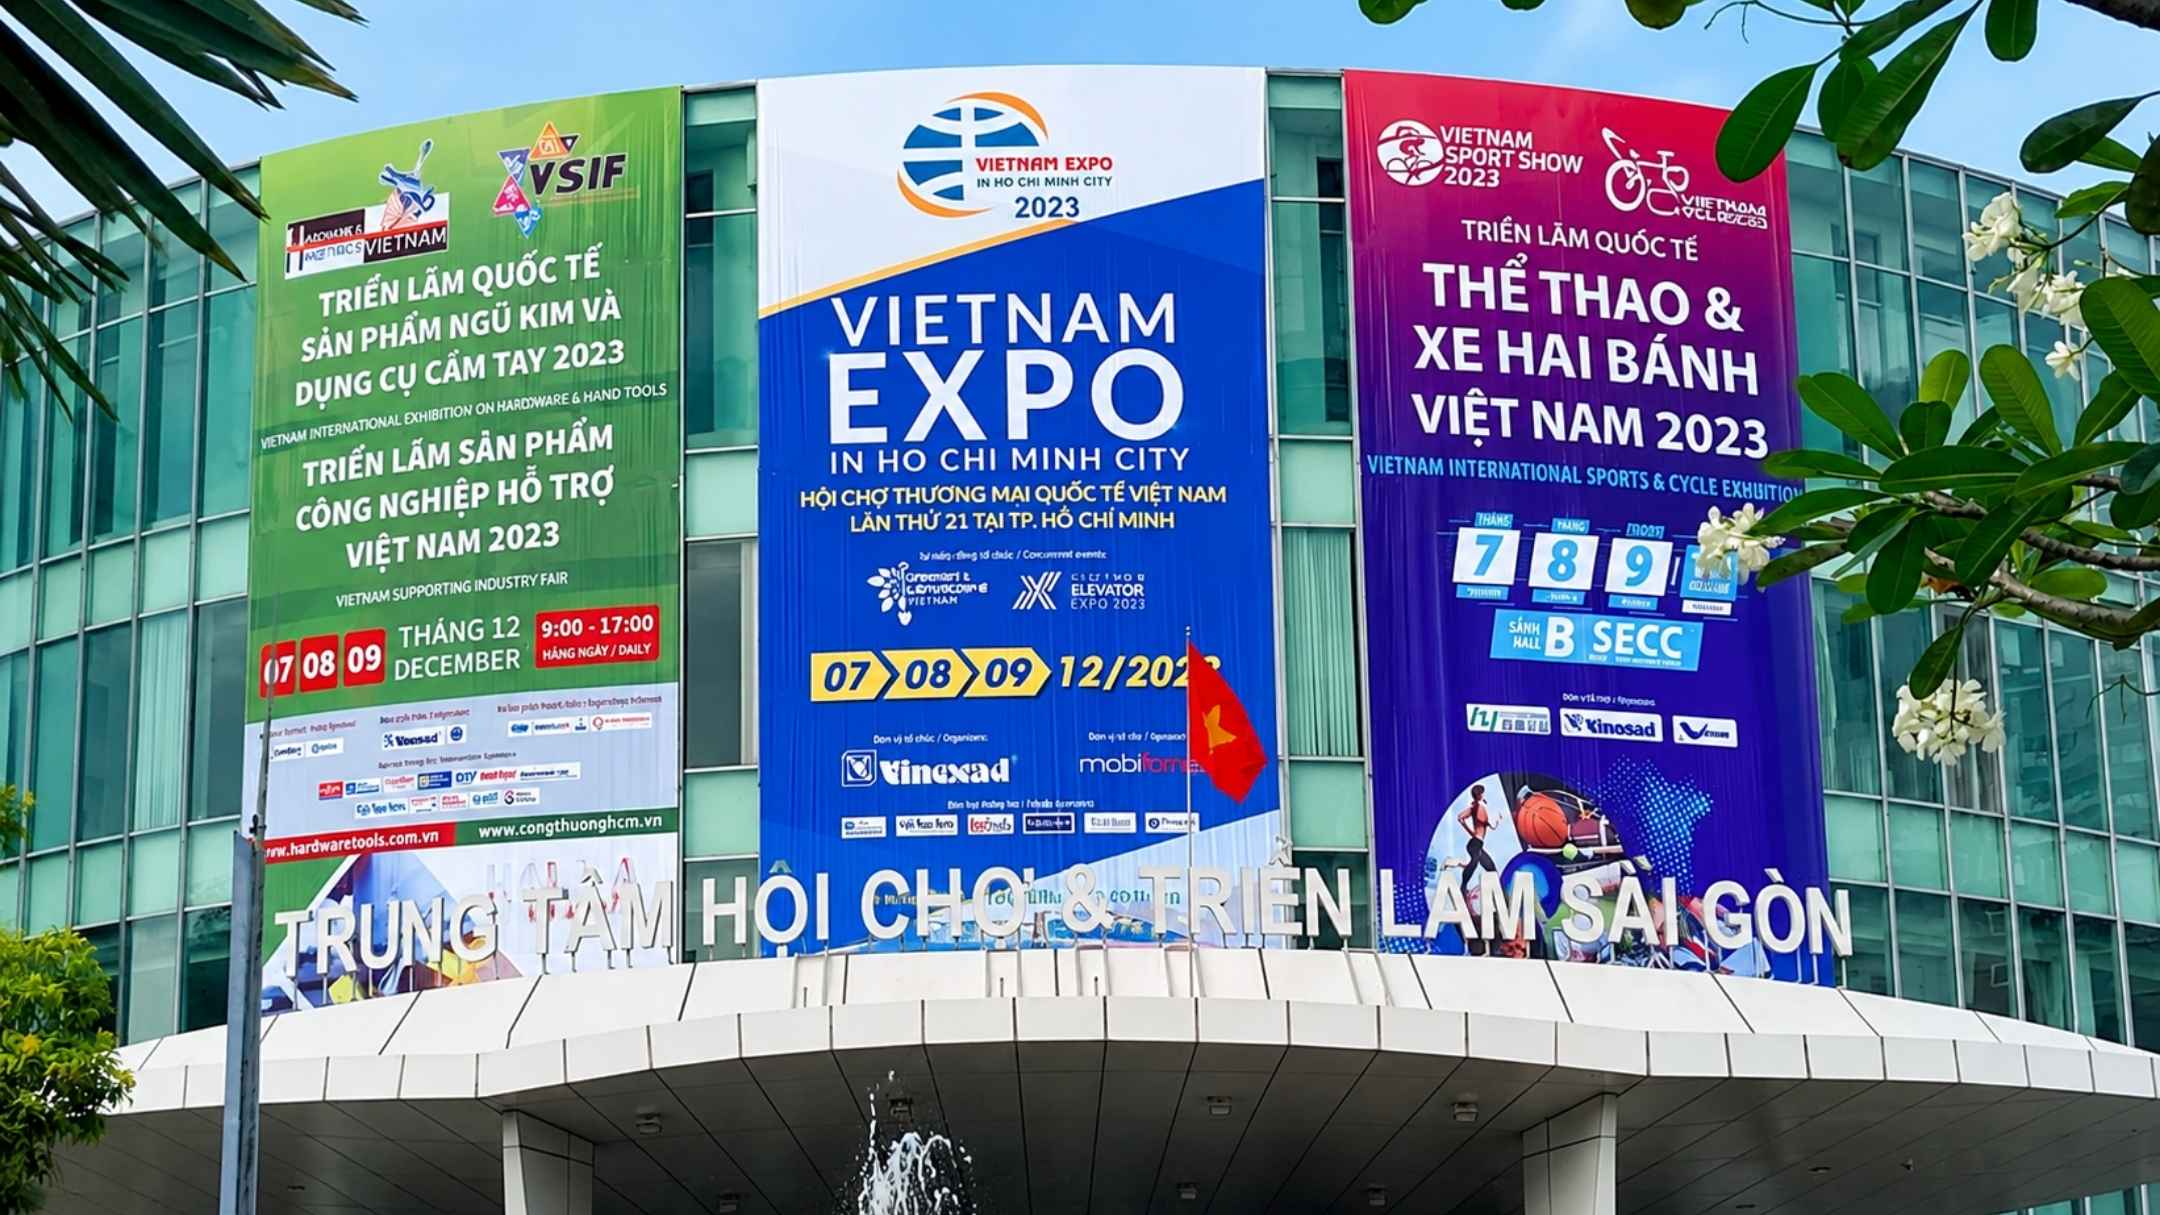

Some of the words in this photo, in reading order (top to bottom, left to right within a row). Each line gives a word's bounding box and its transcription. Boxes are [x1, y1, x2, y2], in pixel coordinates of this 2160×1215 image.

[1440, 126, 1533, 150] VIETNAM
[530, 154, 626, 196] VSIF
[975, 157, 1058, 172] VIETNAM
[1065, 156, 1113, 171] EXPO
[1444, 167, 1501, 188] 2023
[1445, 147, 1515, 169] SPORT
[1518, 152, 1584, 174] SHOW
[977, 178, 990, 188] IN
[994, 177, 1014, 188] HO
[1017, 177, 1040, 187] CHI
[1044, 176, 1079, 187] MINH
[1083, 176, 1113, 187] CITY
[1015, 196, 1080, 219] 2023
[365, 227, 447, 256] VIETNAM
[1538, 221, 1589, 249] LÃM
[1671, 233, 1699, 262] TẾ
[472, 250, 557, 297] QUỐC
[565, 242, 603, 280] TẾ
[520, 300, 575, 330] KIM
[582, 288, 621, 322] VÀ
[1422, 252, 1530, 313] THỂ
[1538, 270, 1690, 327] THAO
[1704, 286, 1744, 332] &
[830, 292, 1175, 347] VIETNAM
[295, 370, 372, 410] DỤNG
[379, 363, 417, 397] CỤ
[493, 347, 547, 377] TAY
[553, 339, 625, 370] 2023
[1413, 325, 1483, 372] XE
[1499, 329, 1592, 380] HAI
[1606, 334, 1759, 396] BÁNH
[829, 348, 1185, 445] EXPO
[261, 428, 307, 449] VIETNAM
[309, 413, 401, 440] INTERNATIONAL
[404, 405, 473, 424] EXHIBITION
[475, 402, 495, 415] ON
[583, 388, 622, 403] HAND
[624, 383, 667, 398] TOOLS
[1411, 388, 1519, 448] VIỆT
[1532, 400, 1644, 448] NAM
[1655, 411, 1769, 459] 2023
[830, 450, 864, 475] IN
[878, 449, 927, 473] HO
[940, 448, 996, 472] CHI
[1011, 447, 1101, 472] MINH
[1115, 447, 1190, 471] CITY
[1367, 455, 1444, 477] VIETNAM
[1448, 458, 1582, 485] INTERNATIONAL
[1586, 467, 1648, 490] SPORTS
[1653, 474, 1665, 490] &
[1669, 475, 1718, 496] CYCLE
[295, 496, 372, 531] CÔNG
[379, 477, 490, 518] NGHIỆP
[498, 465, 541, 507] HỖ
[549, 465, 615, 506] TRỢ
[801, 486, 837, 511] HỘI
[841, 487, 889, 510] CHỢ
[894, 485, 986, 505] THƯƠNG
[992, 486, 1030, 508] MẠI
[1035, 480, 1097, 506] QUỐC
[1100, 481, 1125, 502] TẾ
[1129, 482, 1173, 507] VIỆT
[1178, 486, 1227, 503] NAM
[895, 508, 942, 532] THỨ
[945, 513, 969, 530] 21
[973, 512, 1004, 533] TẠI
[1009, 512, 1037, 529] TP.
[1079, 507, 1114, 528] CHÍ
[1119, 512, 1175, 529] MINH
[346, 533, 410, 573] VIỆT
[416, 529, 481, 561] NAM
[488, 521, 560, 552] 2023
[1474, 534, 1504, 576] 7
[1548, 539, 1579, 582] 8
[1625, 545, 1653, 587] 9
[336, 588, 391, 608] VIETNAM
[393, 580, 473, 602] SUPPORTING
[474, 573, 540, 593] INDUSTRY
[540, 571, 568, 586] FAIR
[1071, 600, 1108, 610] EXPO
[1113, 599, 1146, 610] 2023
[1072, 584, 1144, 597] ELEVATOR
[399, 617, 484, 649] THÁNG
[492, 616, 521, 639] 12
[541, 618, 583, 638] 9:00
[600, 614, 654, 634] 17:00
[1514, 636, 1541, 650] HALL
[1544, 617, 1574, 657] B
[1593, 620, 1682, 659] SECC
[264, 655, 294, 685] 07
[303, 649, 335, 680] 08
[347, 644, 382, 673] 09
[394, 648, 521, 681] DECEMBER
[619, 643, 652, 655] DAILY
[824, 661, 871, 691] 07
[905, 660, 951, 689] 08
[984, 658, 1033, 688] 09
[479, 815, 663, 838] www.congthuonghcm.vn
[275, 891, 497, 976] TRUNG
[522, 861, 674, 954] TÂM
[702, 860, 828, 956] HỘI
[861, 867, 1036, 946] CHỢ
[1062, 863, 1112, 933] &
[1561, 860, 1678, 946] SÀI
[1704, 868, 1853, 957] GÒN
